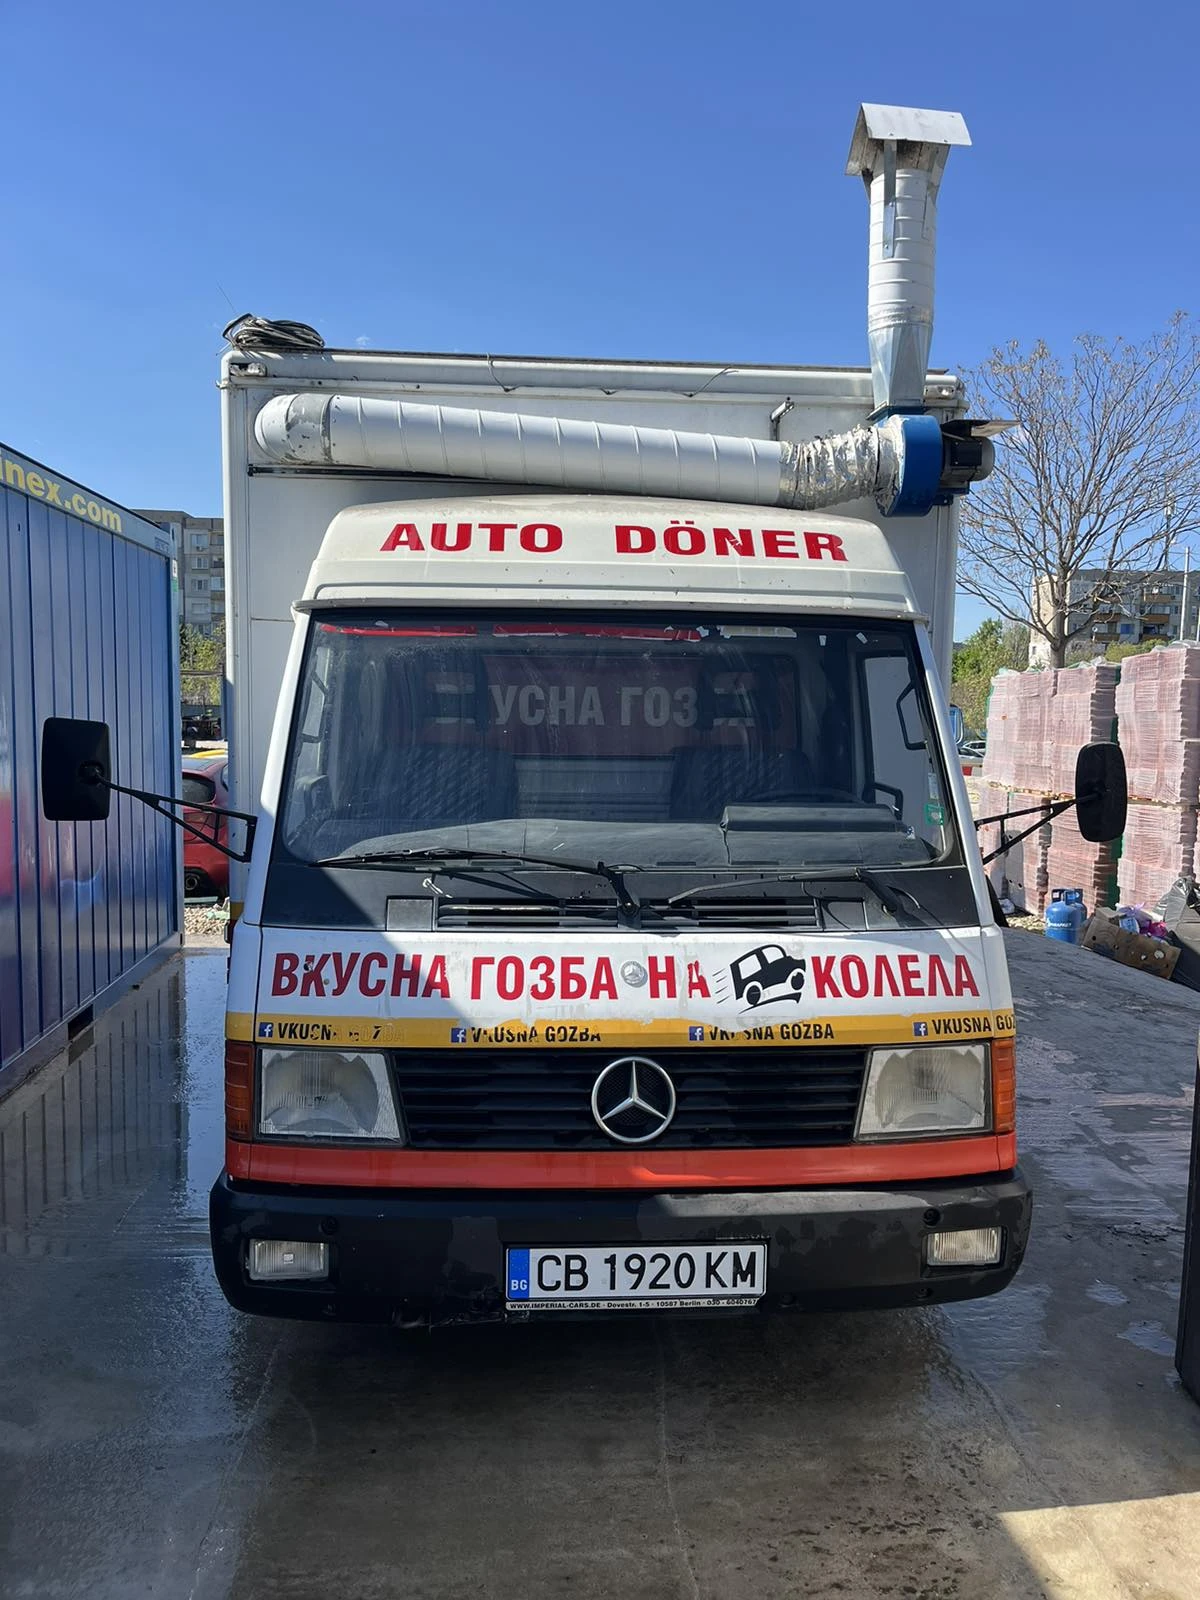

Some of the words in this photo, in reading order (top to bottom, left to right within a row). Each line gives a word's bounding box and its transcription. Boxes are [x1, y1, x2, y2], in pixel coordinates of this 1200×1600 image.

[379, 522, 563, 553] AUTO
[615, 520, 849, 562] DÖNER
[435, 684, 605, 727] УСНА
[271, 952, 451, 998] ВКУСНА
[470, 955, 618, 1000] ГОЗБА
[648, 955, 711, 999] НА
[811, 953, 980, 998] КОЛЕЛА
[278, 1022, 337, 1041] VKUSN
[780, 1023, 835, 1040] GOZBA
[932, 1015, 991, 1035] VKUSNA
[511, 1279, 528, 1291] BG
[537, 1254, 589, 1292] CB
[604, 1251, 696, 1291] 1920
[705, 1250, 757, 1289] KM
